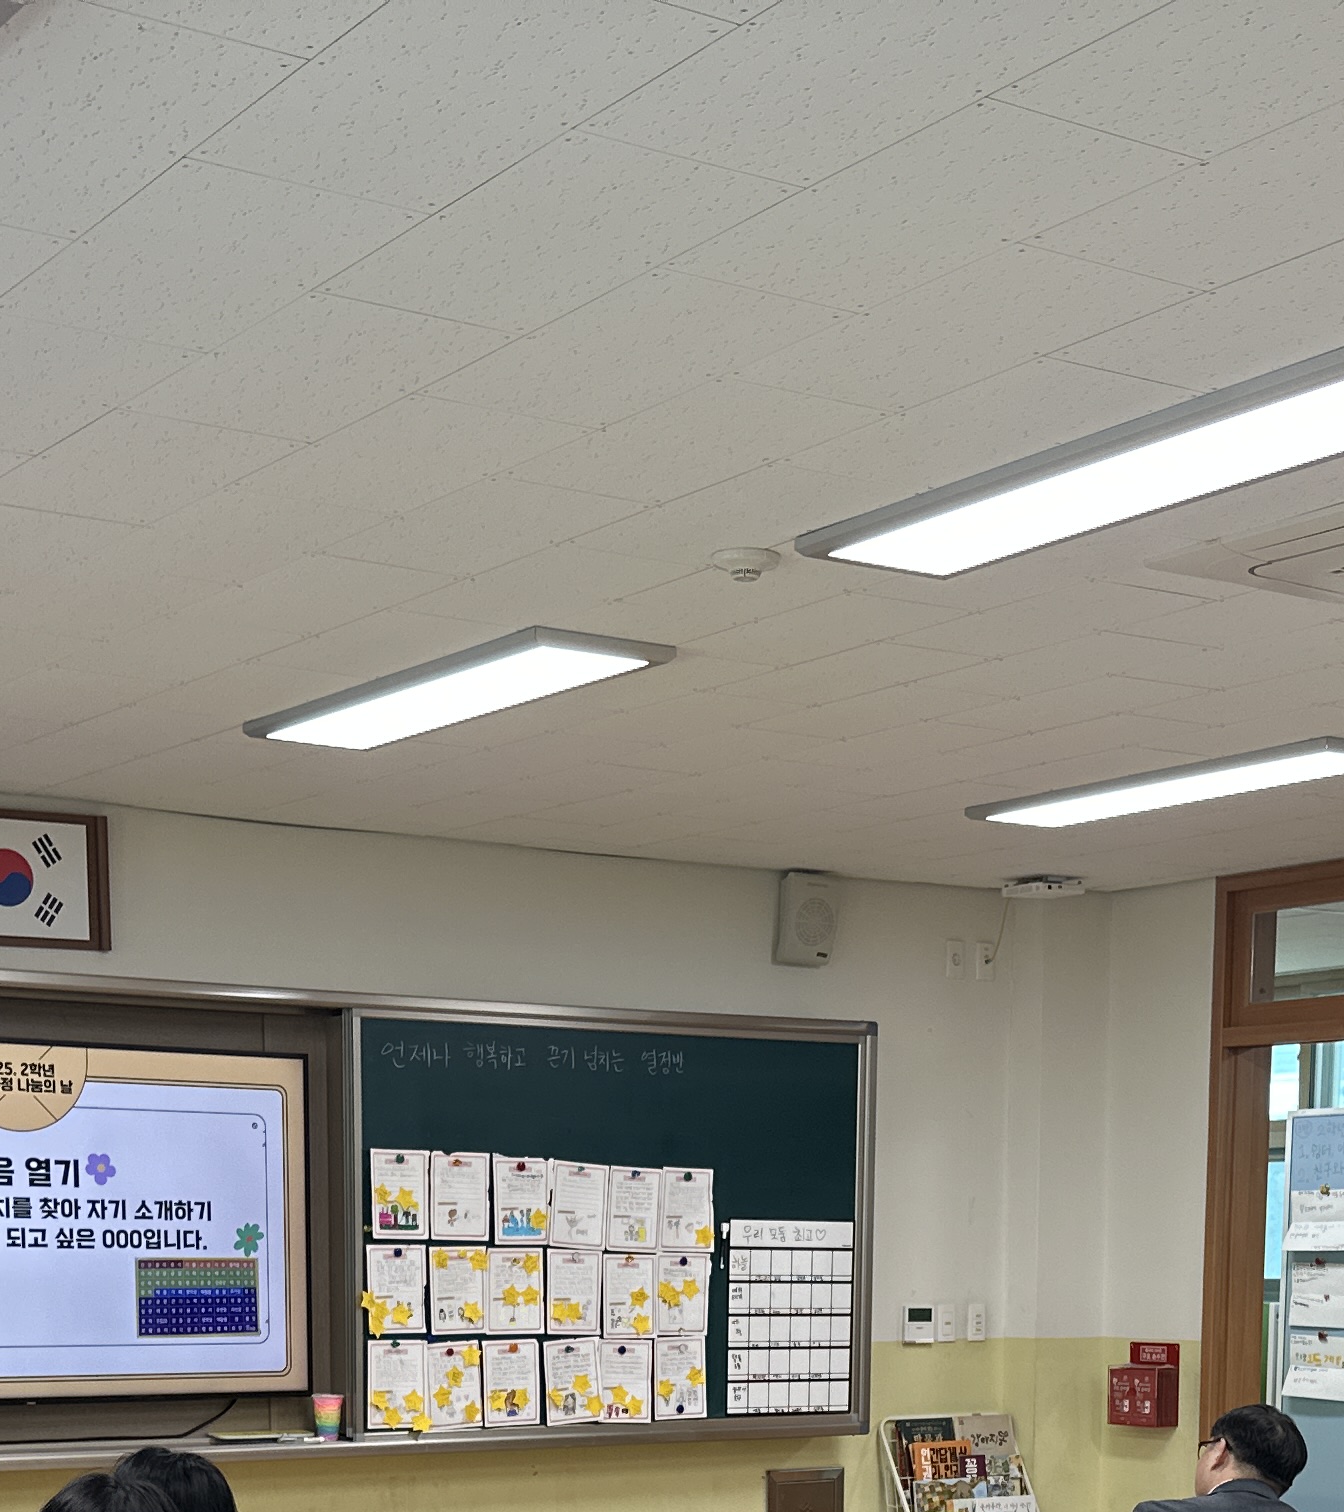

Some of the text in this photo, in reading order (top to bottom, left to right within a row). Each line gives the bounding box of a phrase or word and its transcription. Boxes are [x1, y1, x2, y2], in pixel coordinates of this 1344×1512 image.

[381, 1041, 683, 1075] 언제나 행복하고 끈기 넘치는 열정반
[20, 1062, 55, 1078] 2학년
[17, 1078, 56, 1093] 나눔의
[60, 1080, 73, 1094] 날
[25, 1157, 80, 1188] 열기
[39, 1197, 81, 1220] 찾아
[87, 1199, 126, 1220] 자기
[134, 1199, 212, 1221] 소개하기
[7, 1227, 48, 1249] 되고
[56, 1228, 96, 1250] 싶은
[742, 1225, 763, 1244] 우리
[793, 1226, 812, 1241] 최고
